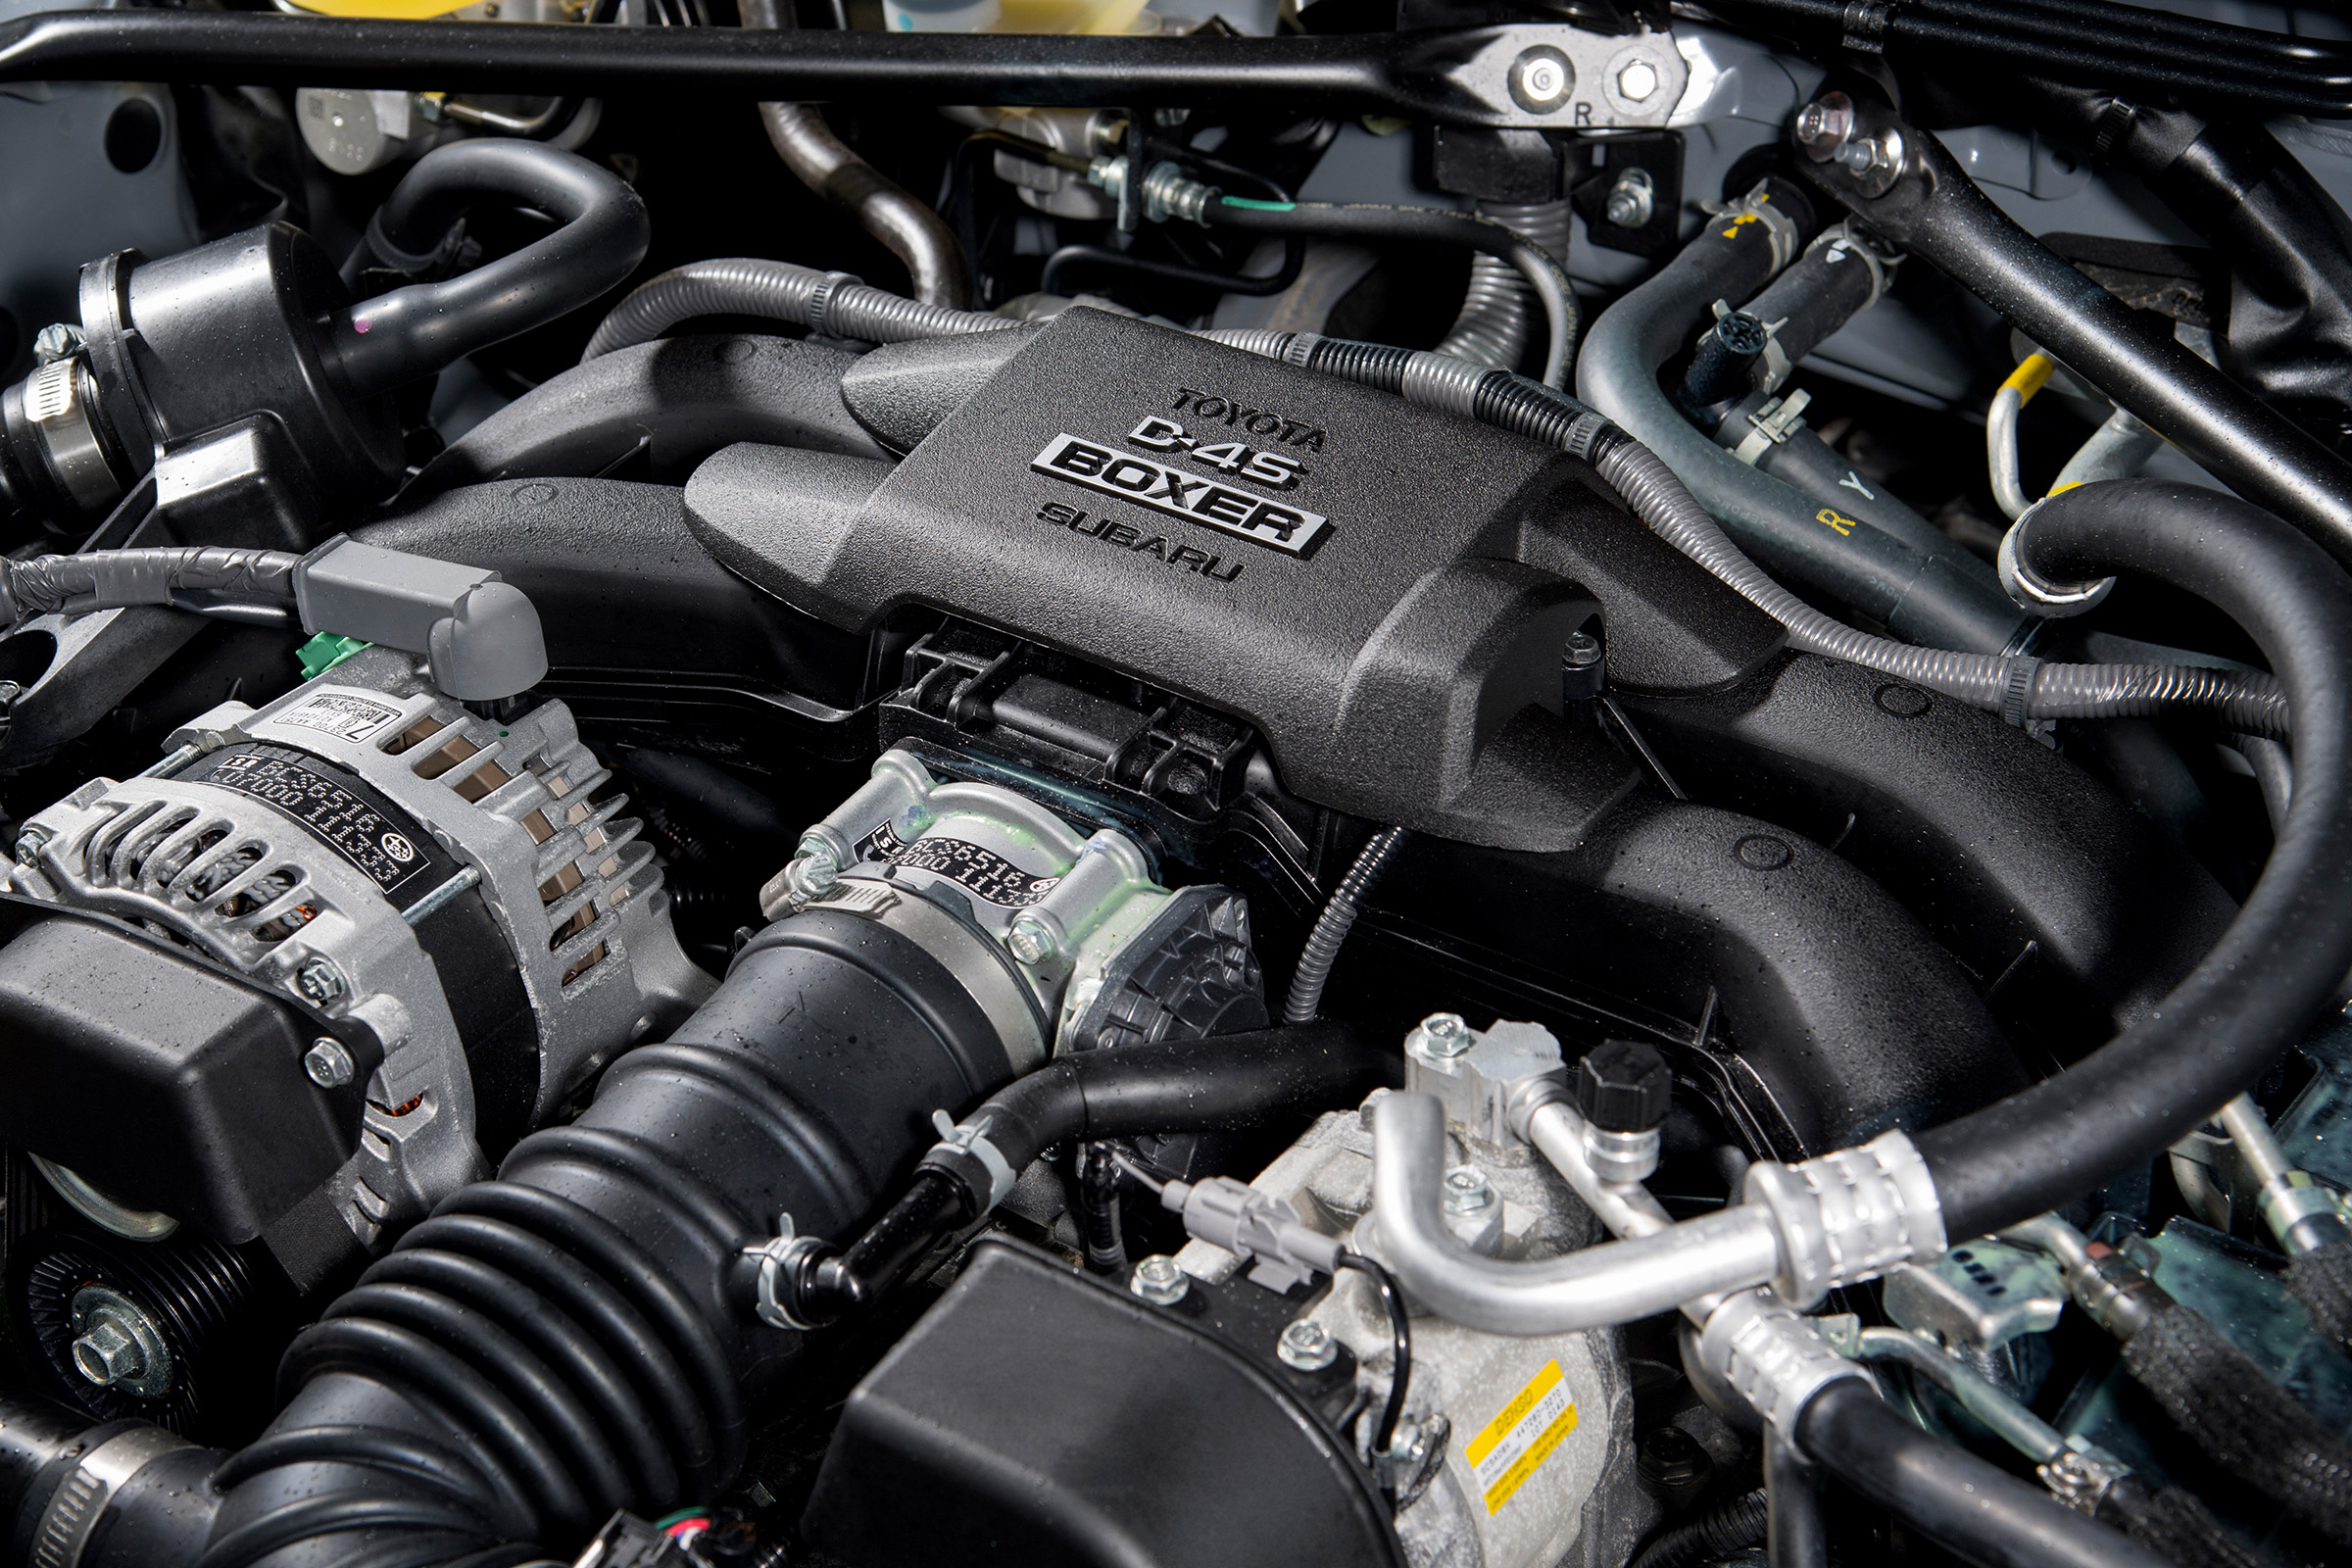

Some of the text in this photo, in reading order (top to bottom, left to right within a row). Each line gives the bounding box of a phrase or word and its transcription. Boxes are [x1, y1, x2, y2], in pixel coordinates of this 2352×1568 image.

[1575, 102, 1592, 124] R
[1172, 386, 1328, 453] TOYOTA
[1128, 415, 1309, 490] D-4S
[1048, 438, 1309, 545] BOXER
[1838, 470, 1875, 501] Y
[1036, 501, 1247, 583] SUBARU
[1815, 508, 1856, 537] R
[345, 725, 375, 741] 7
[304, 800, 400, 882] 111333
[1494, 1388, 1534, 1435] DENSO
